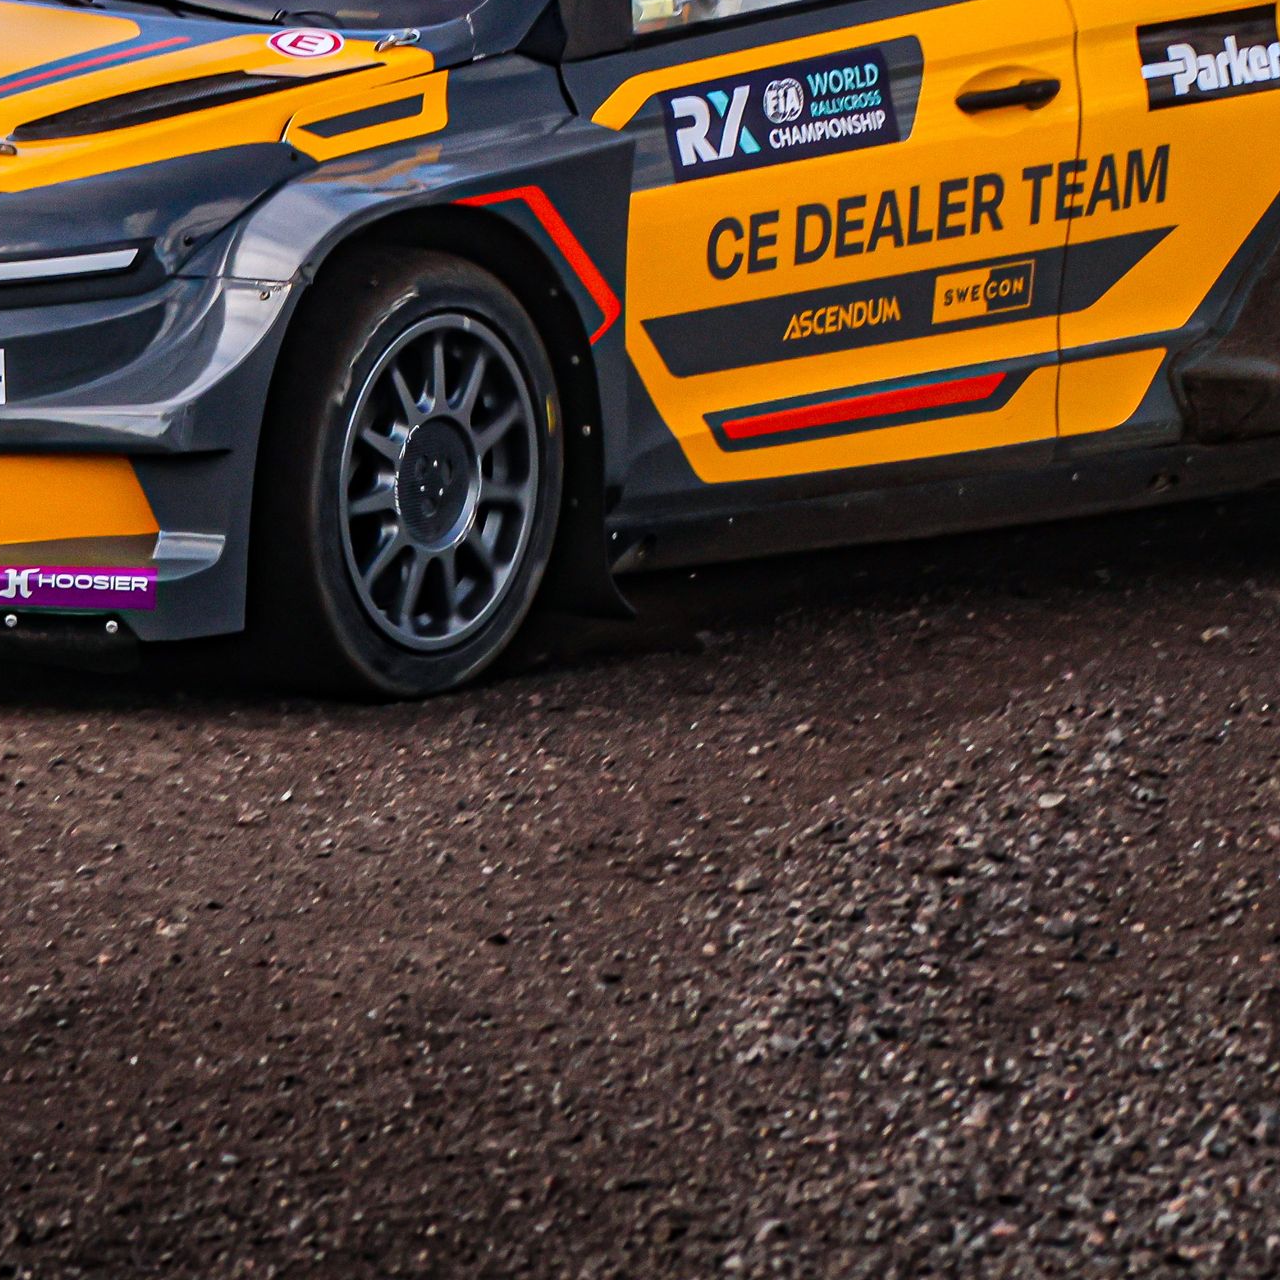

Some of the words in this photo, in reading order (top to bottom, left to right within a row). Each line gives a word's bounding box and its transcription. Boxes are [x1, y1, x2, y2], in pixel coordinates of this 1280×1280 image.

[763, 77, 805, 124] FIA
[807, 63, 879, 98] WORLD
[810, 89, 882, 117] RALLYCROSS
[671, 85, 762, 166] RX
[769, 109, 886, 149] CHAMPIONSHIP
[706, 209, 781, 280] CE
[792, 173, 1005, 262] DEALER
[1022, 144, 1171, 225] TEAM
[943, 275, 1024, 306] SWECON
[782, 296, 901, 341] ASCENDUM
[38, 574, 148, 592] HOOSIER
